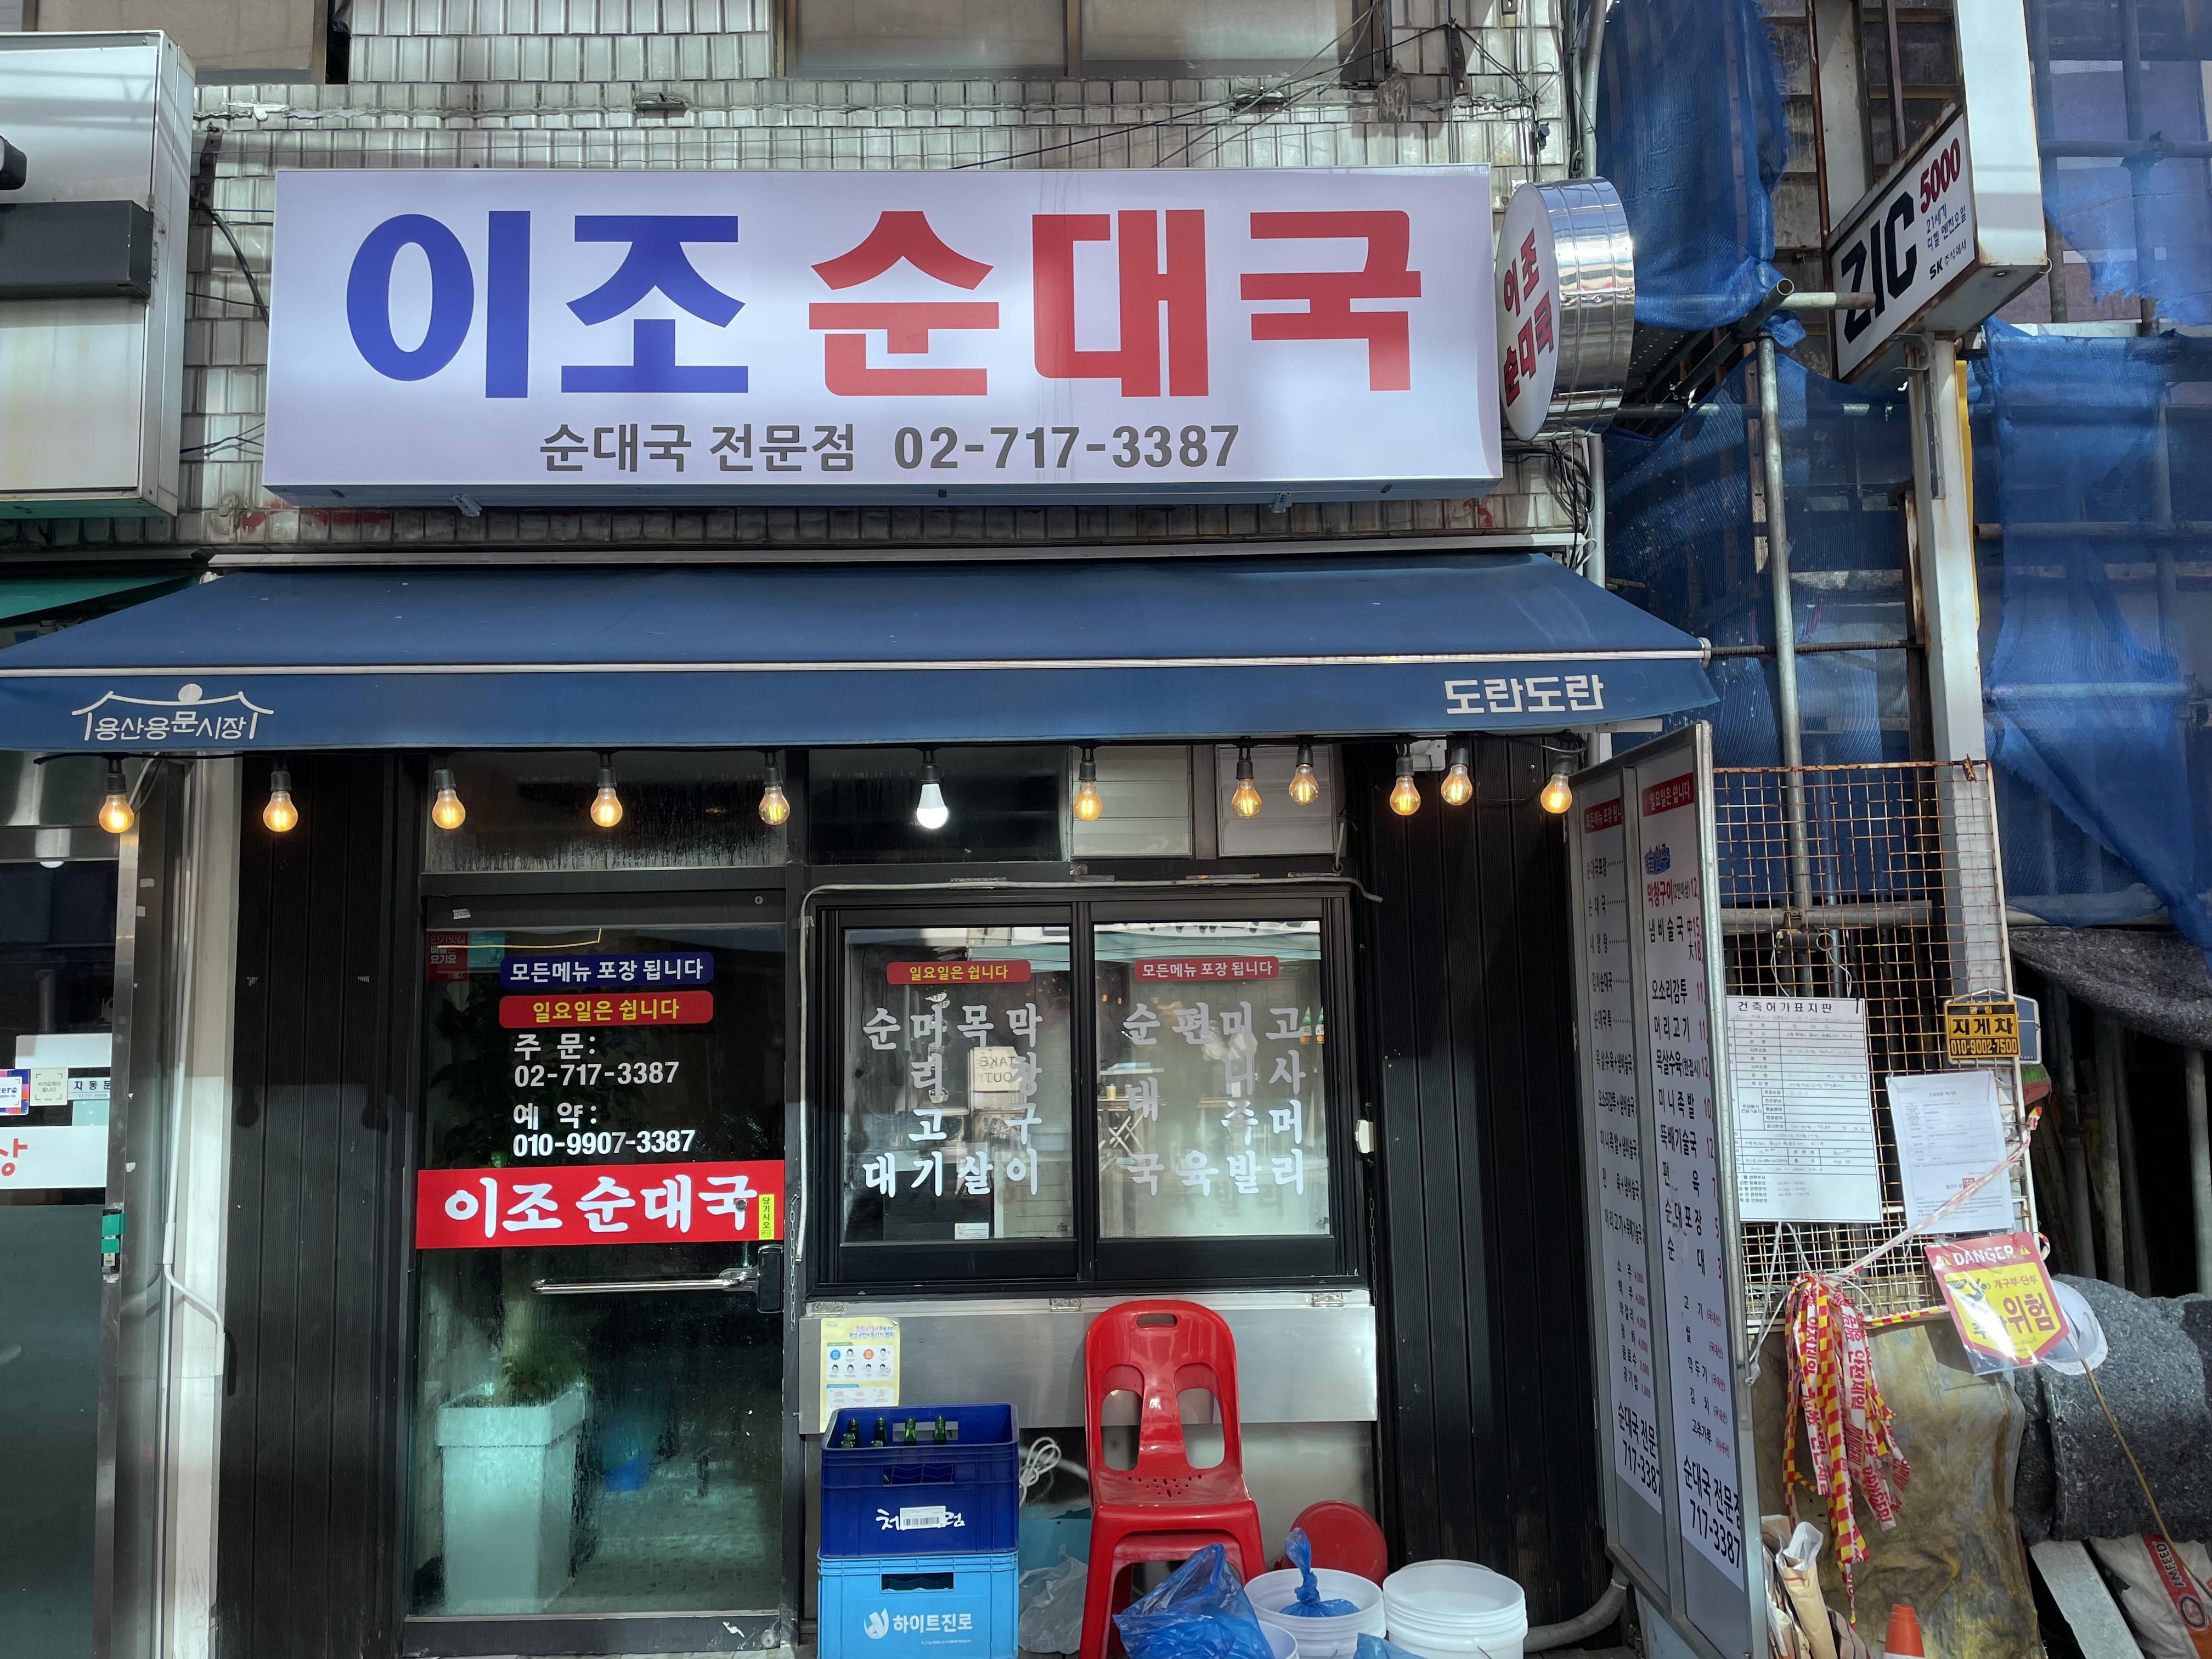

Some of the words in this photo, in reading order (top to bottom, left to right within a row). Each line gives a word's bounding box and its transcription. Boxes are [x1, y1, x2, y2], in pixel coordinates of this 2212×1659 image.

[1920, 138, 1960, 213] 5000
[1927, 203, 1946, 234] 21세기
[1927, 230, 1939, 252] 디젤
[1504, 227, 1539, 316] 이조
[1841, 191, 1917, 344] ZIC
[1929, 257, 1944, 280] SK
[1944, 238, 1966, 266] 주식회사
[346, 211, 748, 398] 이조
[809, 209, 1421, 397] 순대국
[1504, 291, 1554, 408] 순대국
[540, 424, 691, 471] 순대국
[709, 424, 853, 471] 전문점
[894, 425, 1239, 469] 02-717-3387
[1444, 674, 1604, 714] 도란도란
[95, 711, 247, 741] 용산용문시장
[1650, 787, 1672, 811] 일요일은
[1673, 780, 1690, 804] 쉽니다
[1647, 843, 1668, 874] 술안주
[431, 934, 465, 944] 인기맛집
[430, 955, 456, 964] 요기요
[510, 962, 591, 983] 모든메뉴
[597, 960, 637, 980] 포장
[643, 958, 703, 979] 됩니다
[910, 966, 964, 981] 일요일은
[967, 964, 1008, 980] 쉽니다
[1142, 963, 1197, 978] 모든메뉴
[1201, 962, 1228, 977] 포장
[1231, 961, 1272, 977] 됩니다
[1652, 979, 1688, 1005] 오소리감투
[1738, 1001, 1832, 1013] 건축허가표지판
[533, 1000, 613, 1023] 일요일은
[619, 998, 680, 1021] 쉽니다
[1953, 1018, 2013, 1035] 지게차
[1951, 1039, 2017, 1055] 010-9002-7500
[515, 1062, 679, 1087] 02-717-3387
[513, 1130, 695, 1156] 010-9907-3387
[1661, 1124, 1697, 1159] 뚝배기술국
[444, 1177, 562, 1238] 이조
[575, 1174, 757, 1233] 순대국
[1952, 1245, 2013, 1266] DANGER
[2003, 1293, 2056, 1334] 위험
[1618, 1400, 1639, 1444] 순대국
[1641, 1419, 1658, 1459] 전문
[1692, 1419, 1712, 1446] 고추가루
[1684, 1454, 1711, 1506] 순대국
[876, 1509, 965, 1531] 처럼
[1690, 1498, 1740, 1568] 717-3387
[2156, 1543, 2186, 1587] AMFEED
[893, 1613, 973, 1633] 하이트진로
